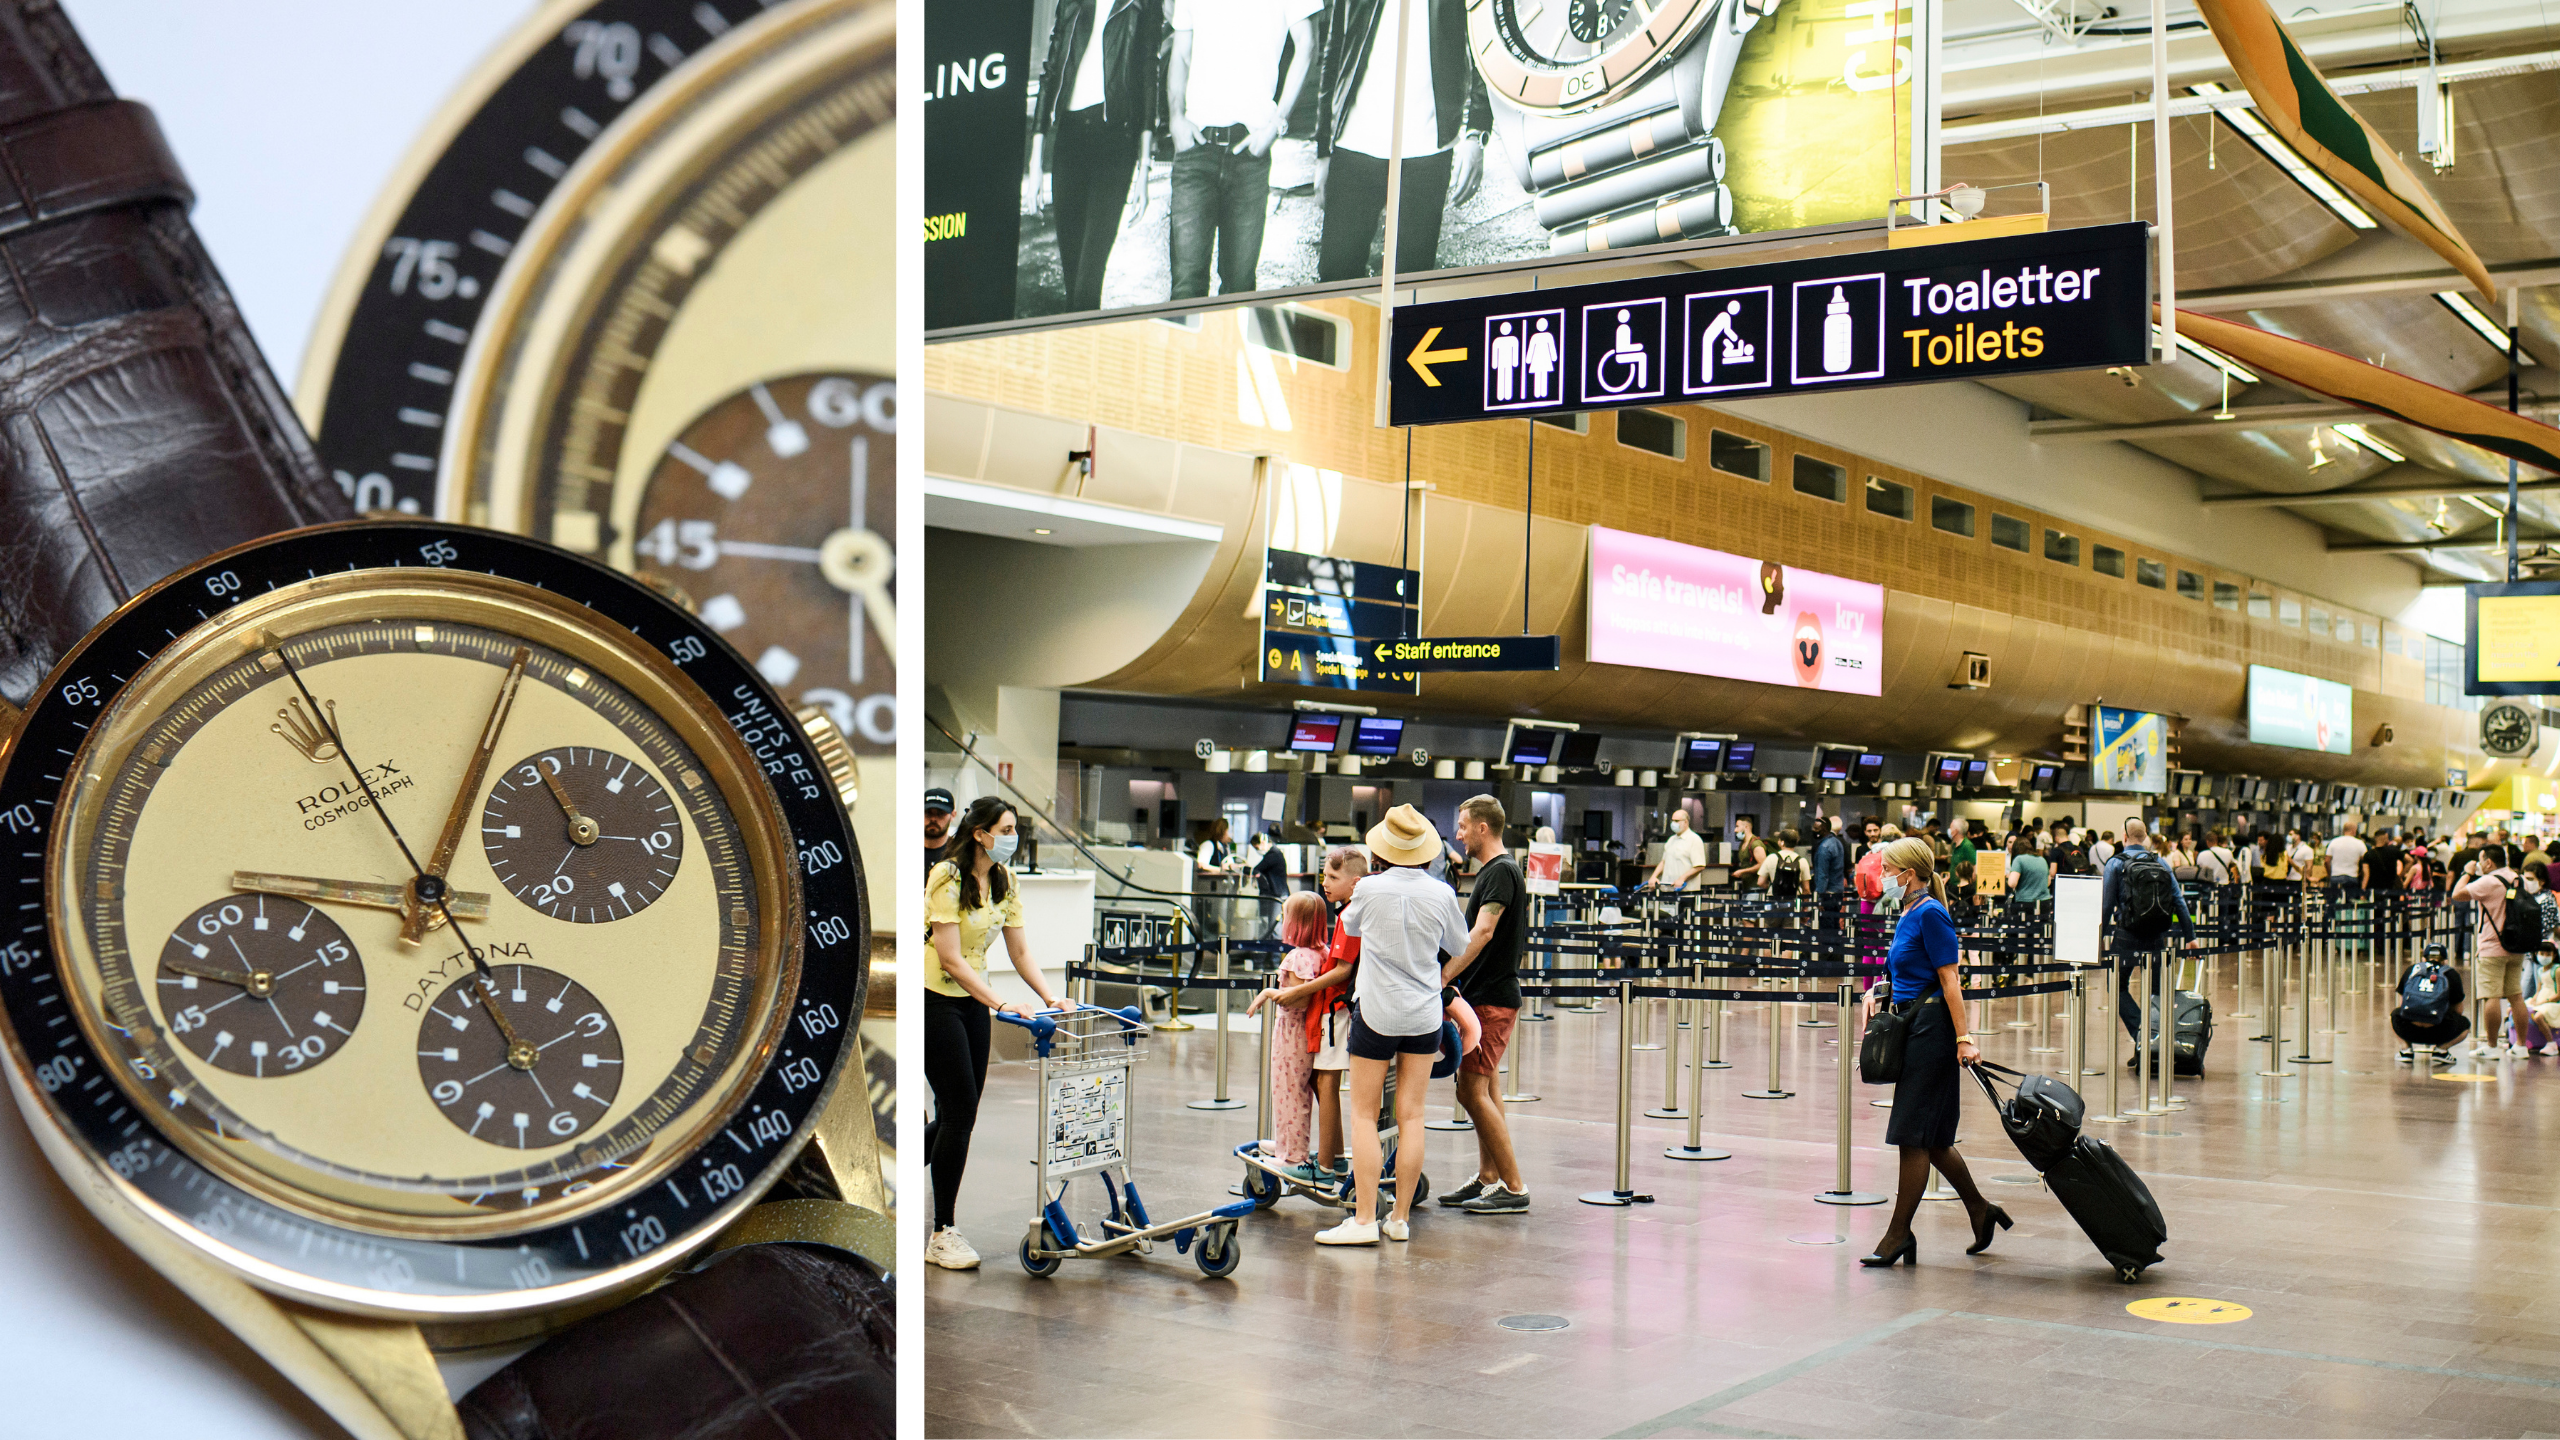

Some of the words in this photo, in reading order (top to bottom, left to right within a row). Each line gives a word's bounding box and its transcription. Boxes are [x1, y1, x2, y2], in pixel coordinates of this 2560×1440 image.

[561, 20, 642, 80] 70
[1844, 0, 1912, 92] CH
[1567, 71, 1595, 95] 30
[384, 237, 460, 299] 75
[1904, 265, 2100, 316] Toaletter
[1904, 320, 2044, 368] Toilets
[808, 378, 896, 433] 60
[333, 470, 395, 514] 0
[420, 540, 458, 567] 55
[636, 519, 719, 570] 45
[206, 570, 242, 597] 60
[1611, 564, 1662, 601] Safe
[1664, 574, 1743, 615] travels!
[1836, 601, 1865, 639] kry
[670, 635, 705, 664] 50
[1290, 650, 1302, 671] A
[1395, 642, 1431, 660] Staff
[1433, 641, 1500, 659] entrance
[62, 676, 99, 707] 65
[730, 711, 785, 776] HOUR
[733, 685, 791, 749] UNITS
[785, 753, 819, 801] PER
[1198, 740, 1213, 757] 33
[1414, 750, 1427, 764] 35
[518, 755, 561, 787] 30
[1600, 760, 1610, 773] 37
[295, 758, 401, 815] ROLEX
[303, 775, 414, 832] COSMOGRAPH
[0, 804, 35, 834] 70
[640, 830, 673, 855] 10
[799, 840, 842, 874] 200
[532, 875, 574, 906] 20
[197, 904, 244, 936] 60
[809, 914, 850, 949] 180
[0, 941, 32, 976] 75
[316, 939, 349, 967] 15
[403, 942, 533, 1013] DAYTONA
[2418, 978, 2434, 993] LA
[172, 1005, 207, 1034] 45
[575, 1012, 607, 1037] 3
[798, 1003, 839, 1038] 160
[277, 1035, 326, 1070] 30
[36, 1055, 77, 1093] 80
[778, 1057, 821, 1093] 150
[433, 1079, 464, 1105] 9
[548, 1113, 578, 1136] 6
[751, 1109, 791, 1147] 140
[108, 1143, 152, 1180] 85
[700, 1162, 745, 1202] 130
[620, 1214, 667, 1257] 120
[510, 1257, 553, 1290] 110
